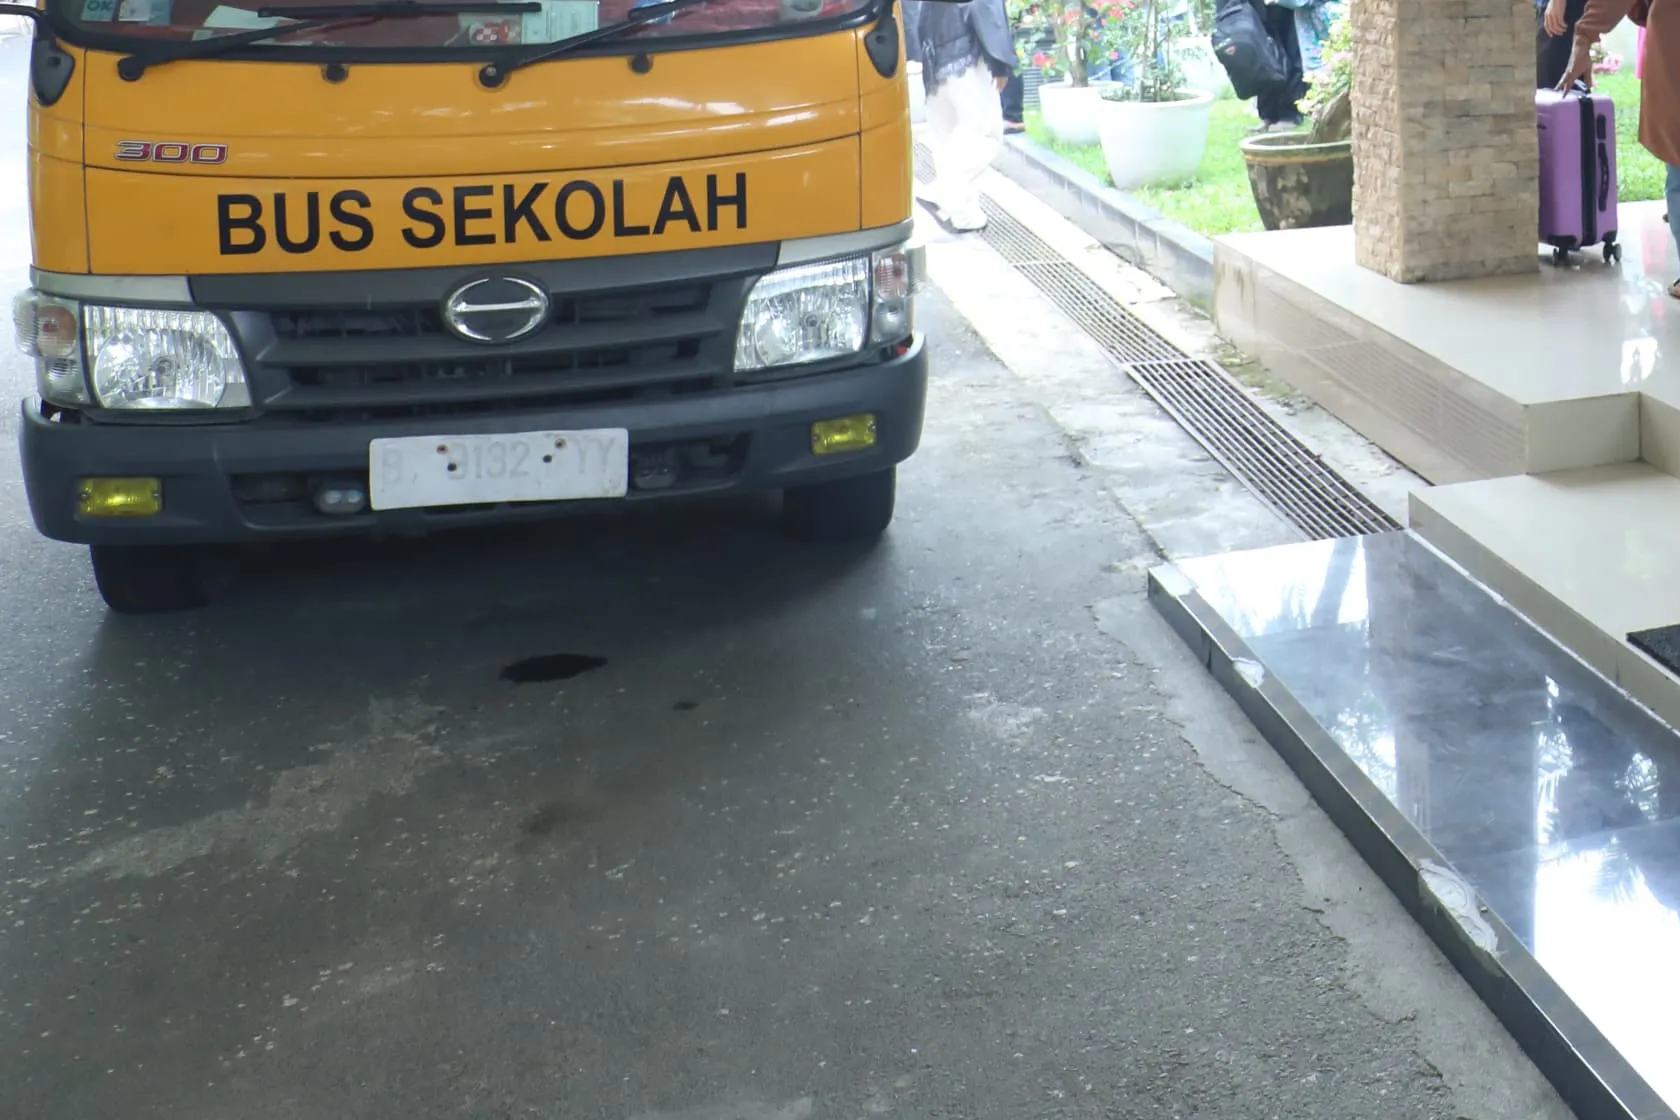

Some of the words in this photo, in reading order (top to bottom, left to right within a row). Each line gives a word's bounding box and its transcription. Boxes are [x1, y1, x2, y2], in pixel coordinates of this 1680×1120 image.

[115, 140, 228, 164] 300
[217, 189, 374, 256] BUS
[401, 171, 748, 249] SEKOLAH
